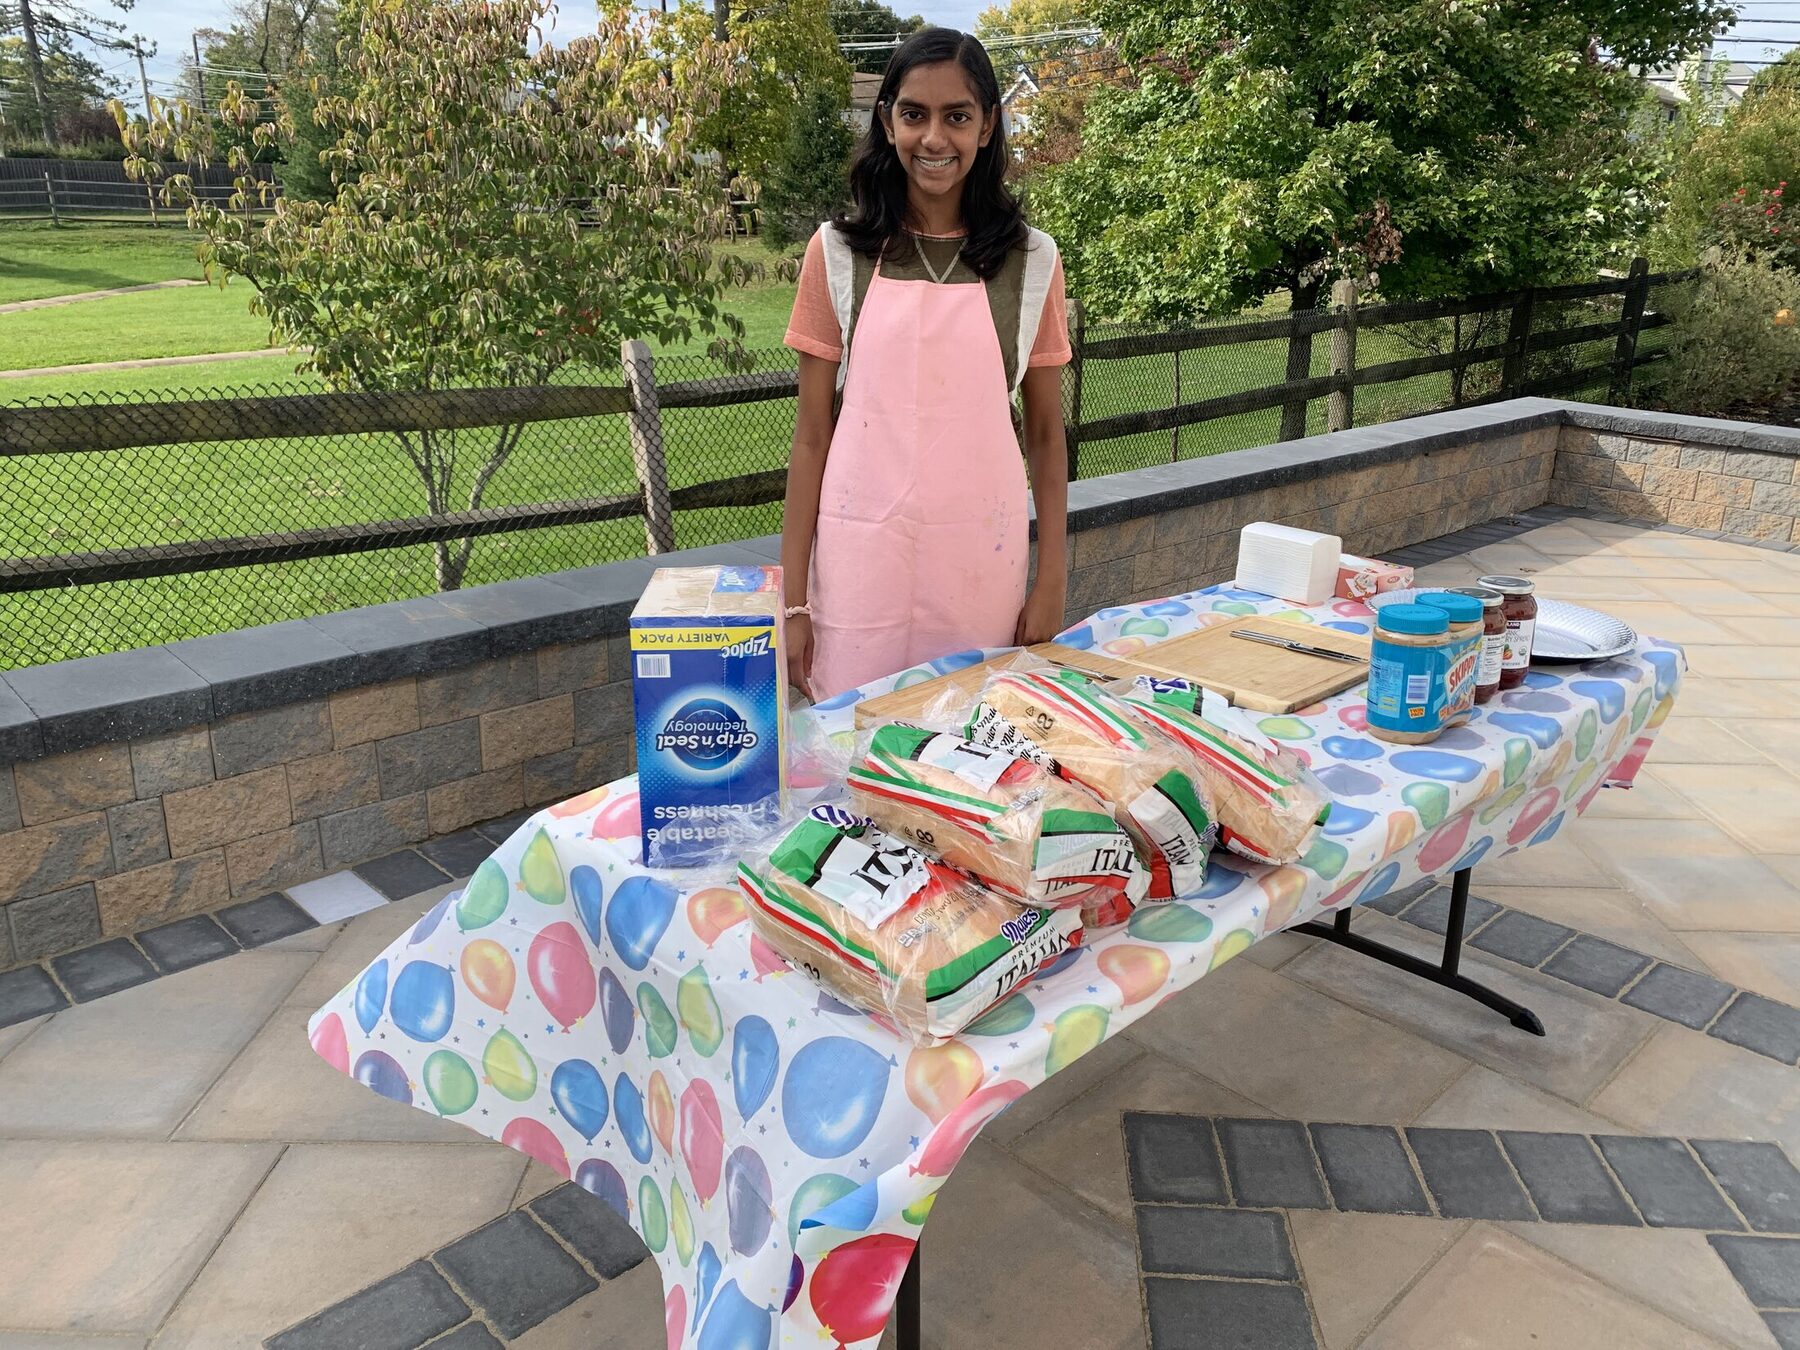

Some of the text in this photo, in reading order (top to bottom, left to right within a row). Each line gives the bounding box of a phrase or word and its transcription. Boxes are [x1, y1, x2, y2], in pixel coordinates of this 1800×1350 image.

[640, 633, 730, 644] VARIETY PACK
[721, 635, 769, 659] Ziploc
[666, 720, 746, 734] Technology
[657, 734, 699, 750] Seal
[653, 804, 766, 820] Freshness
[1089, 848, 1134, 873] ITAL
[1012, 925, 1056, 963] PREMIUM
